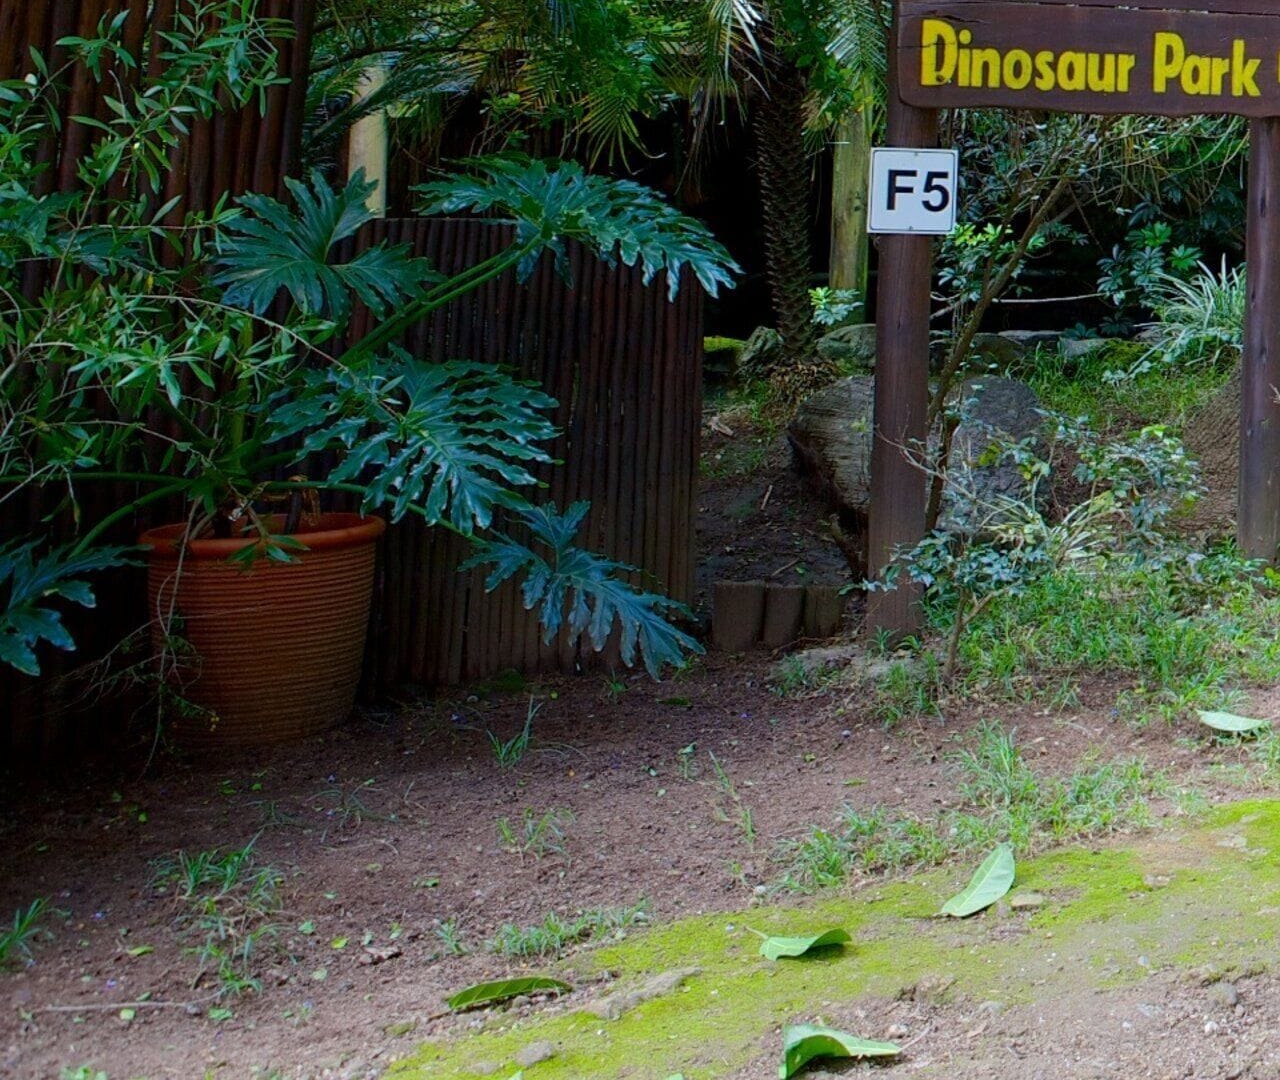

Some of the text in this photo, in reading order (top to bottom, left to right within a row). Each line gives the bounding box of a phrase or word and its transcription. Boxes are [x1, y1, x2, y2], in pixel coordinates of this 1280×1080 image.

[920, 19, 1262, 97] Dinosaur Park
[885, 168, 950, 212] F5
